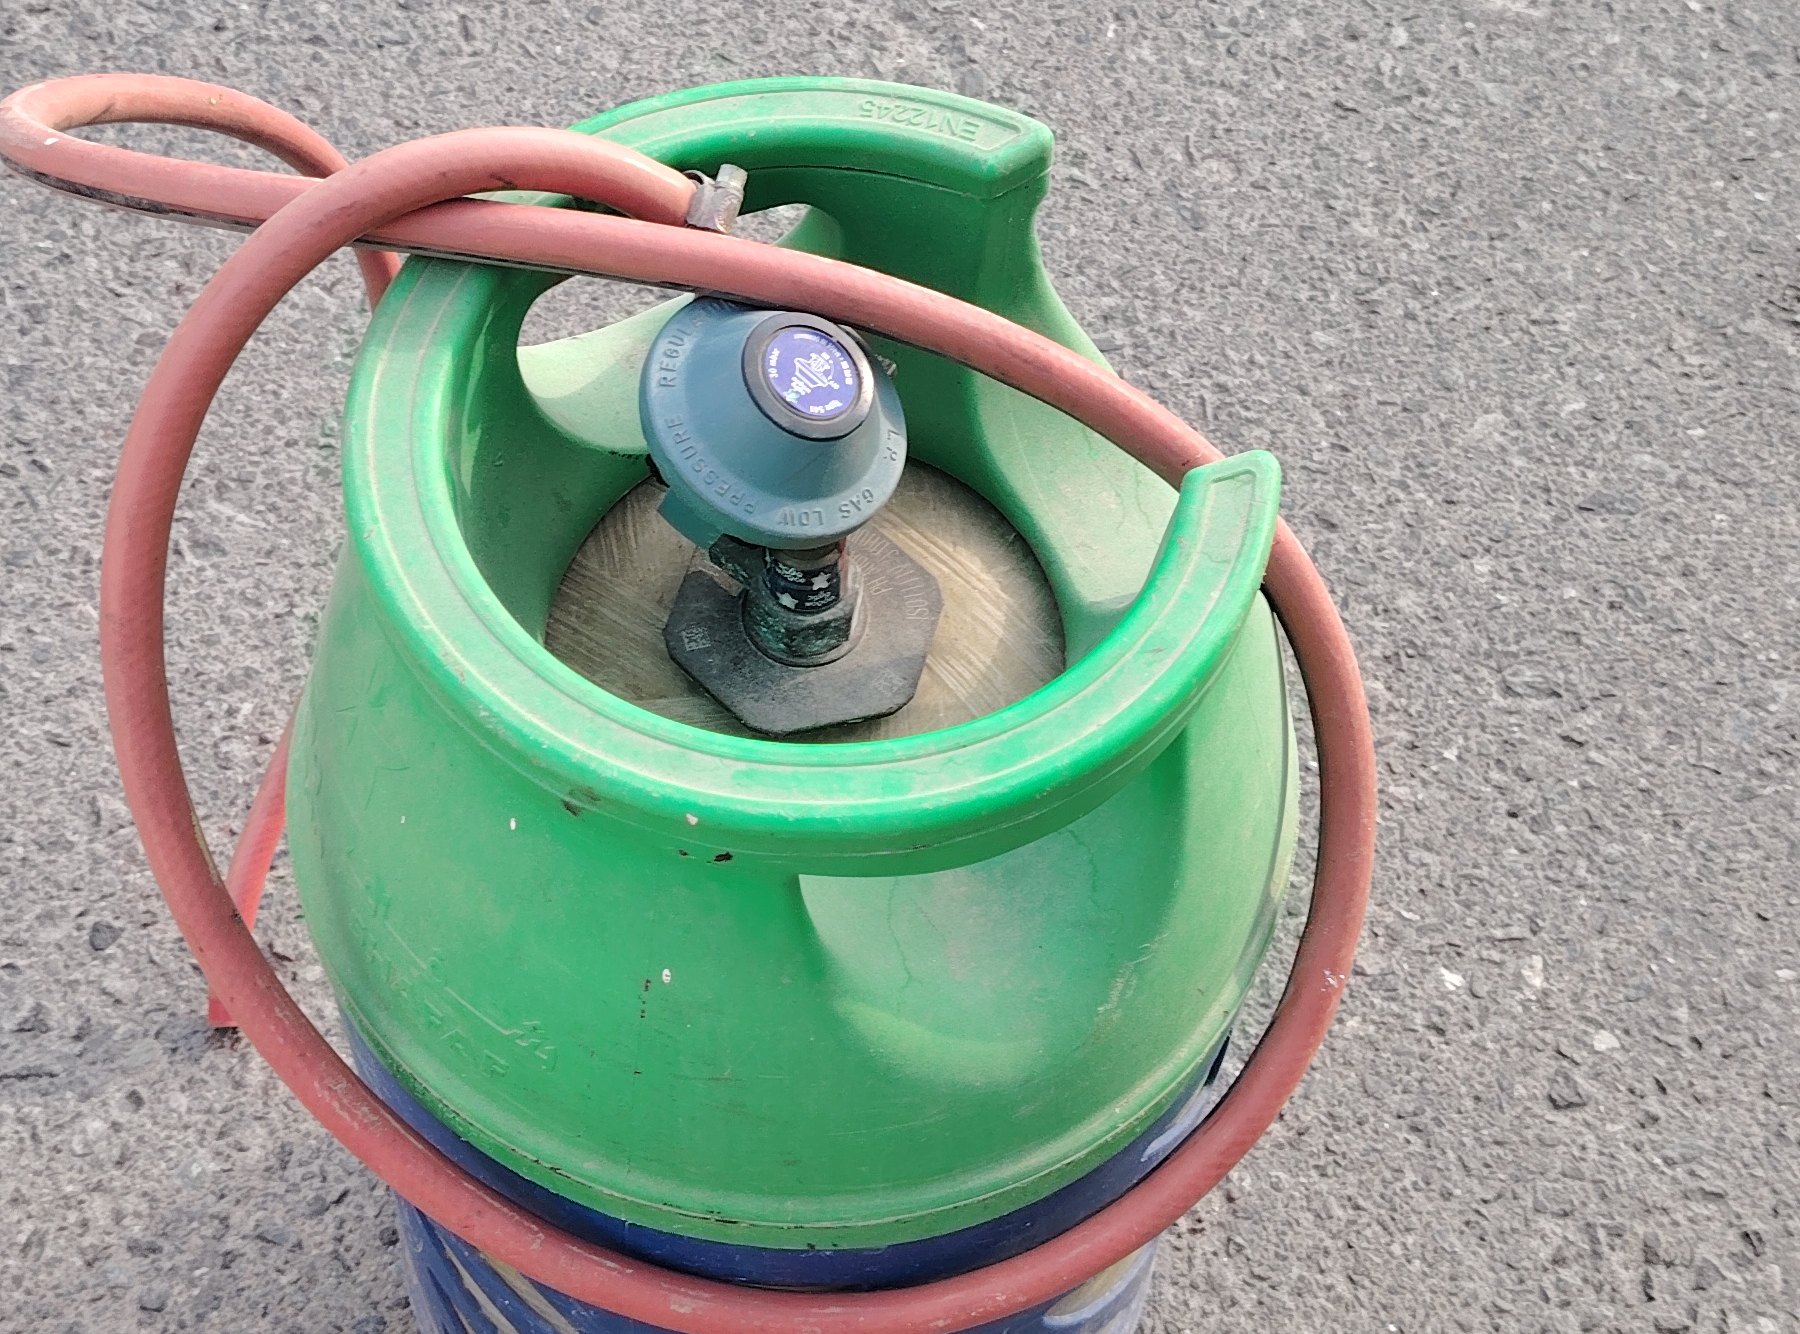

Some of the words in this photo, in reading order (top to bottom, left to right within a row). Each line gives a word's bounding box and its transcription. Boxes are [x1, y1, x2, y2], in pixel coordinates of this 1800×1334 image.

[859, 100, 981, 142] EN12245
[667, 414, 756, 515] PRESSURE
[777, 512, 825, 527] LOW
[838, 487, 874, 518] GAS
